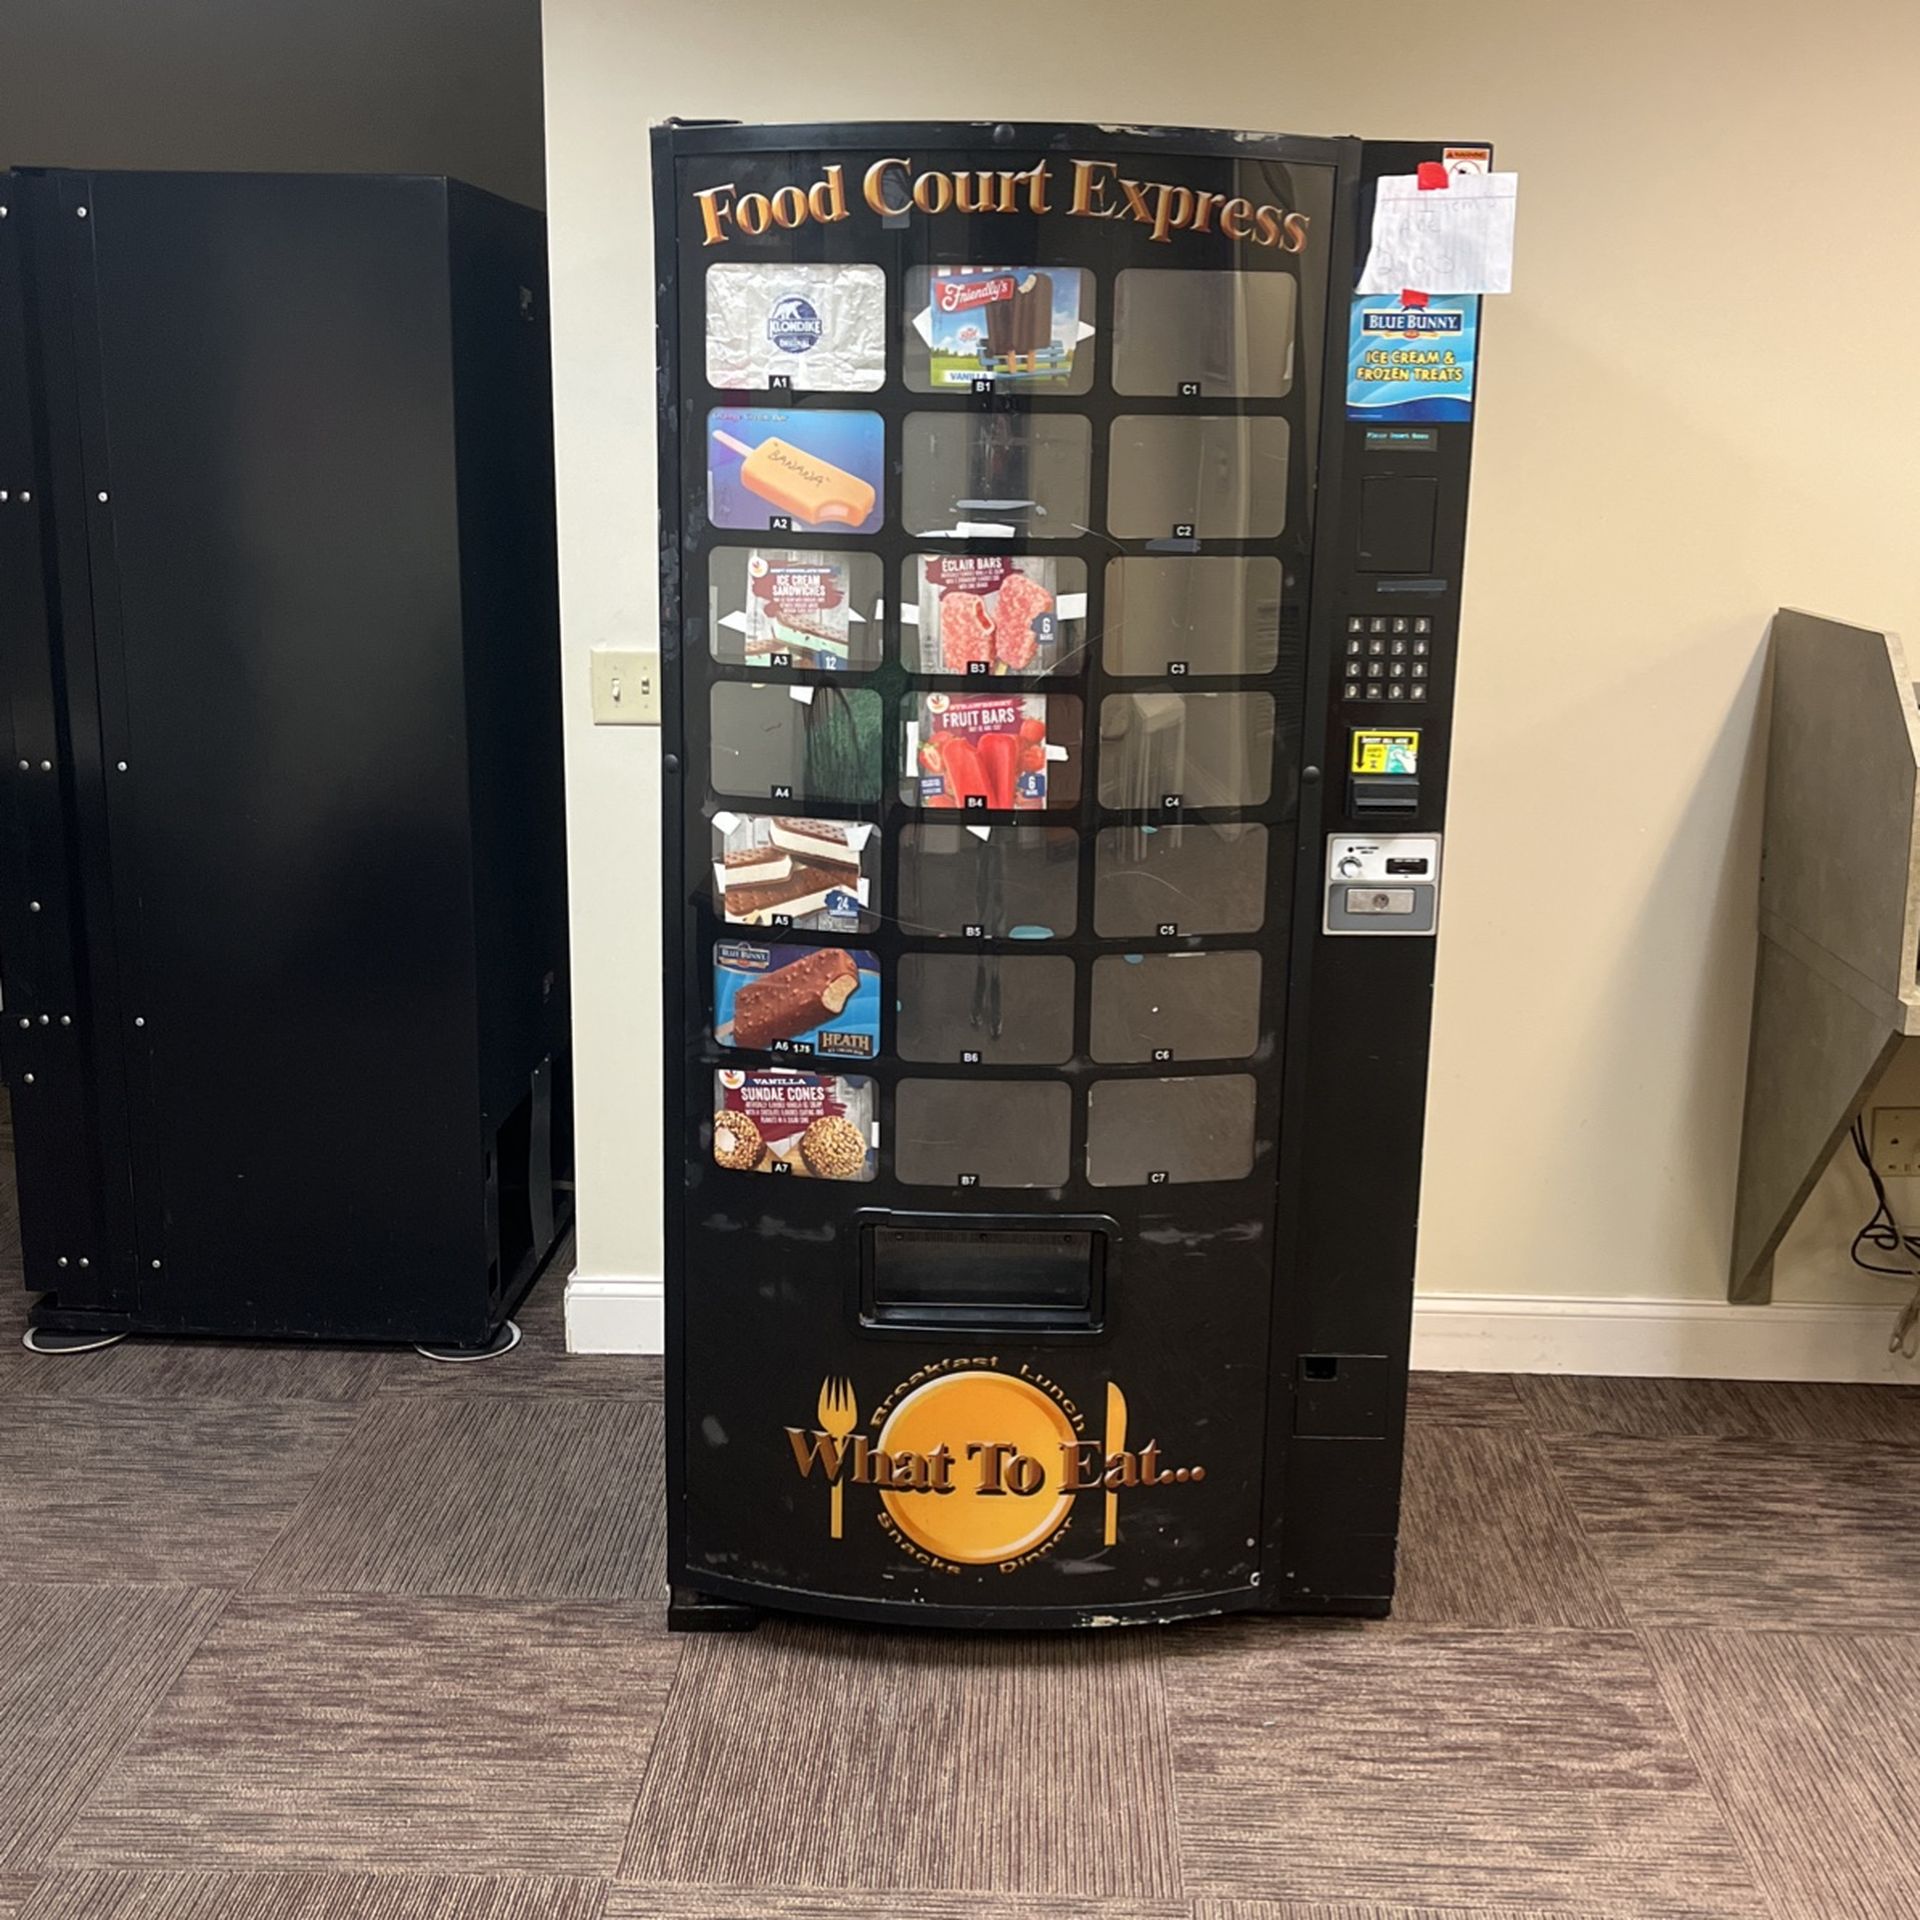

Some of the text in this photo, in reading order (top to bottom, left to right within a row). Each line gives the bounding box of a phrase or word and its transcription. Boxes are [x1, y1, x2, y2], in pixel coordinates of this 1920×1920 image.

[694, 157, 1311, 253] Food Court Express
[941, 280, 1009, 311] Friendly's
[1369, 314, 1458, 329] BLUE BUNNY
[769, 319, 822, 337] KLONDIKE
[1366, 350, 1456, 365] ICE CREAM &
[1356, 367, 1464, 382] FROZEN TREATS
[772, 377, 788, 388] A1
[975, 382, 991, 392] B1
[1182, 384, 1198, 395] C1
[772, 518, 788, 529] A2
[1176, 526, 1192, 537] C2
[976, 557, 1002, 569] BARS
[776, 574, 821, 586] ICE CREAM
[772, 585, 827, 597] SANDWICHES
[1042, 618, 1051, 633] 6
[773, 655, 789, 666] A3
[825, 656, 837, 670] 12
[969, 663, 986, 673] B3
[1170, 664, 1186, 675] C3
[942, 710, 979, 728] FRUIT
[981, 707, 1015, 725] BARS
[1028, 776, 1036, 789] 6
[774, 788, 790, 798] A4
[967, 797, 983, 808] B4
[1165, 797, 1180, 808] C4
[836, 896, 849, 910] 24
[774, 916, 789, 925] A5
[965, 927, 981, 937] B5
[1160, 926, 1175, 935] C5
[774, 1041, 789, 1051] A6
[822, 1032, 870, 1051] HEATH
[963, 1053, 978, 1063] B6
[1155, 1051, 1170, 1060] C6
[741, 1086, 825, 1101] SUNDAE CONES
[774, 1164, 789, 1173] A7
[961, 1176, 976, 1186] B7
[1151, 1173, 1166, 1183] C7
[869, 1355, 1000, 1428] Breakfast
[1019, 1364, 1087, 1433] Lunch
[783, 1425, 955, 1492] What
[966, 1441, 1045, 1496] To
[876, 1511, 963, 1575] Snacks
[999, 1515, 1075, 1575] Dinner
